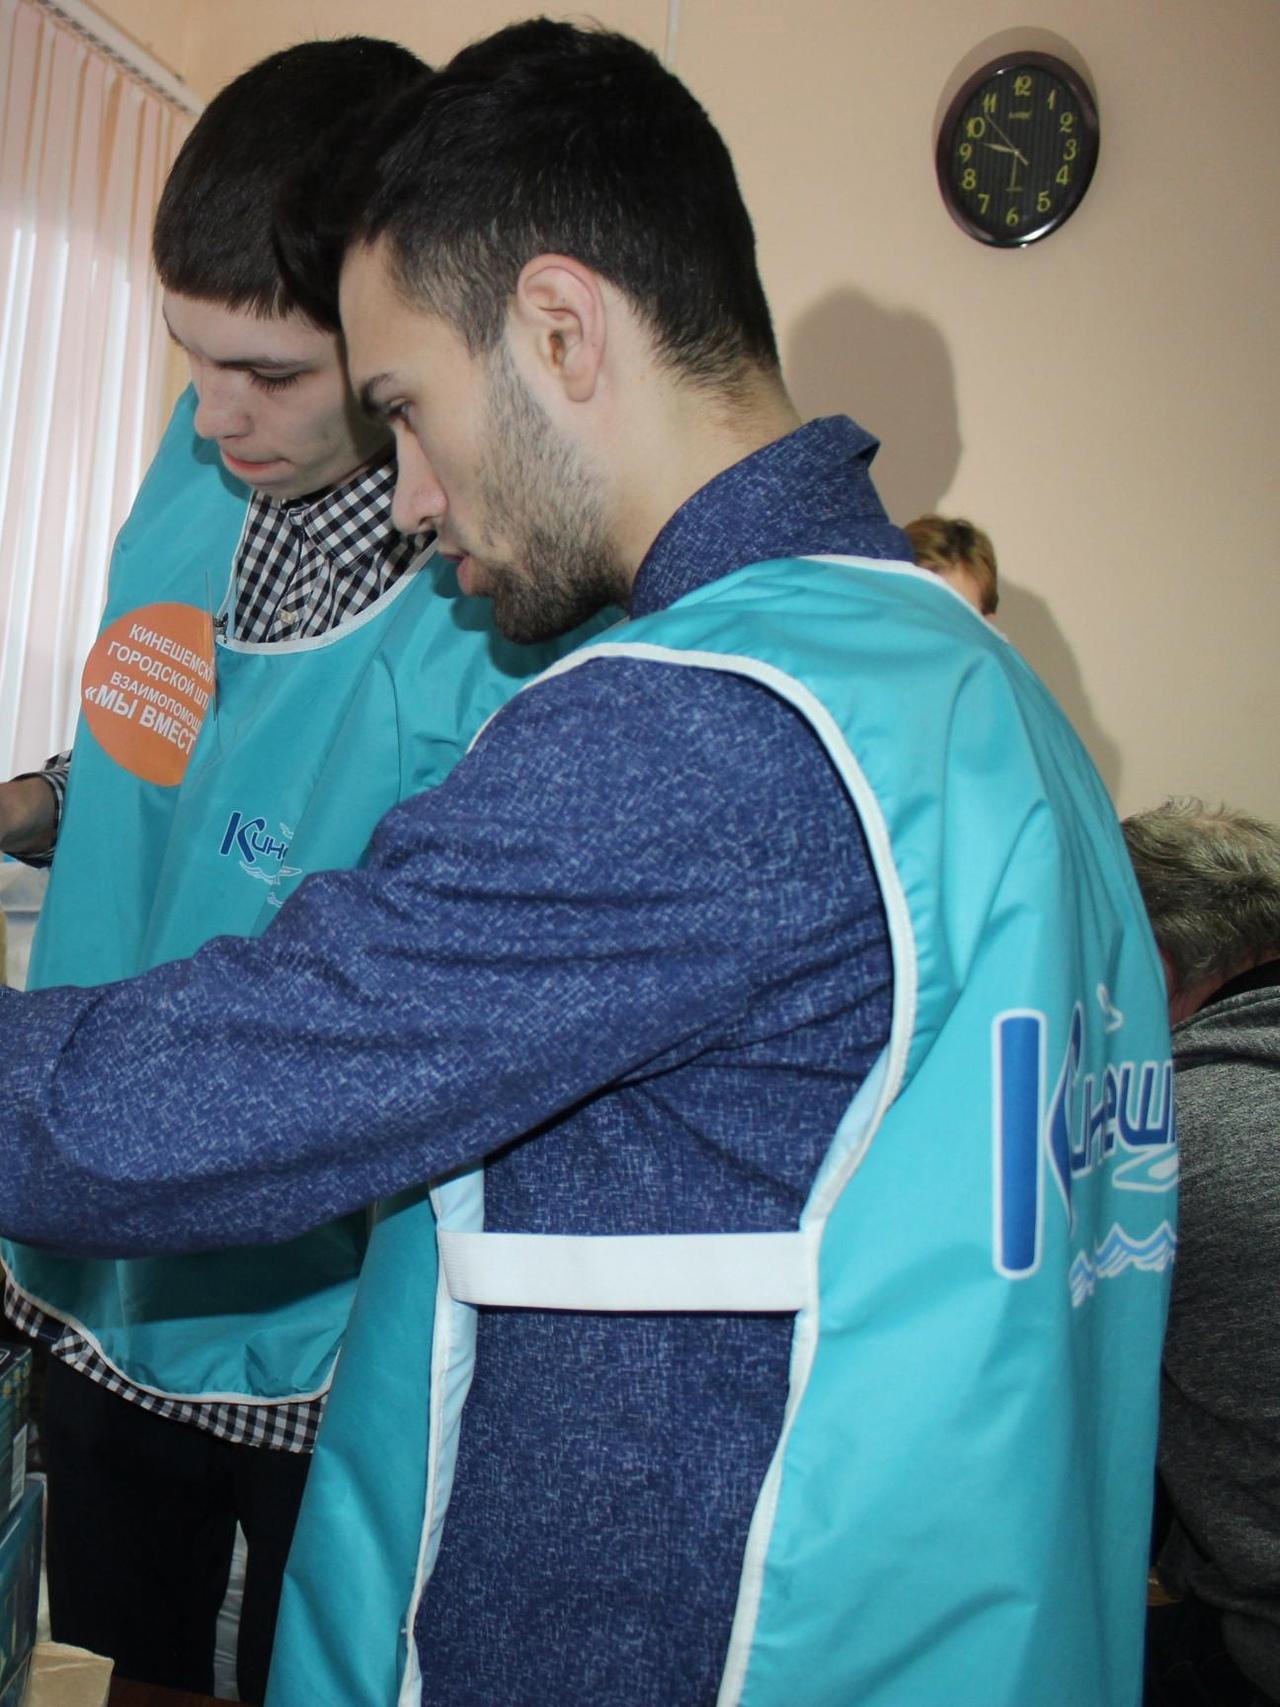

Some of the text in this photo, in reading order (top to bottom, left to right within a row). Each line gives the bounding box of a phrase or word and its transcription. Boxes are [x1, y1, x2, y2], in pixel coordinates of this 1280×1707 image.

[1014, 75, 1032, 96] 12
[982, 92, 997, 113] 11
[1048, 89, 1056, 110] 1
[966, 116, 985, 139] 10
[1059, 112, 1073, 132] 2
[959, 143, 973, 163] 9
[1063, 138, 1077, 160] 3
[962, 168, 976, 190] 8
[1055, 165, 1069, 185] 4
[977, 194, 990, 214] 7
[1036, 190, 1051, 212] 5
[1006, 207, 1019, 226] 6
[107, 641, 195, 699] ГОРОДСКОЙ
[85, 684, 138, 719] «МЫ
